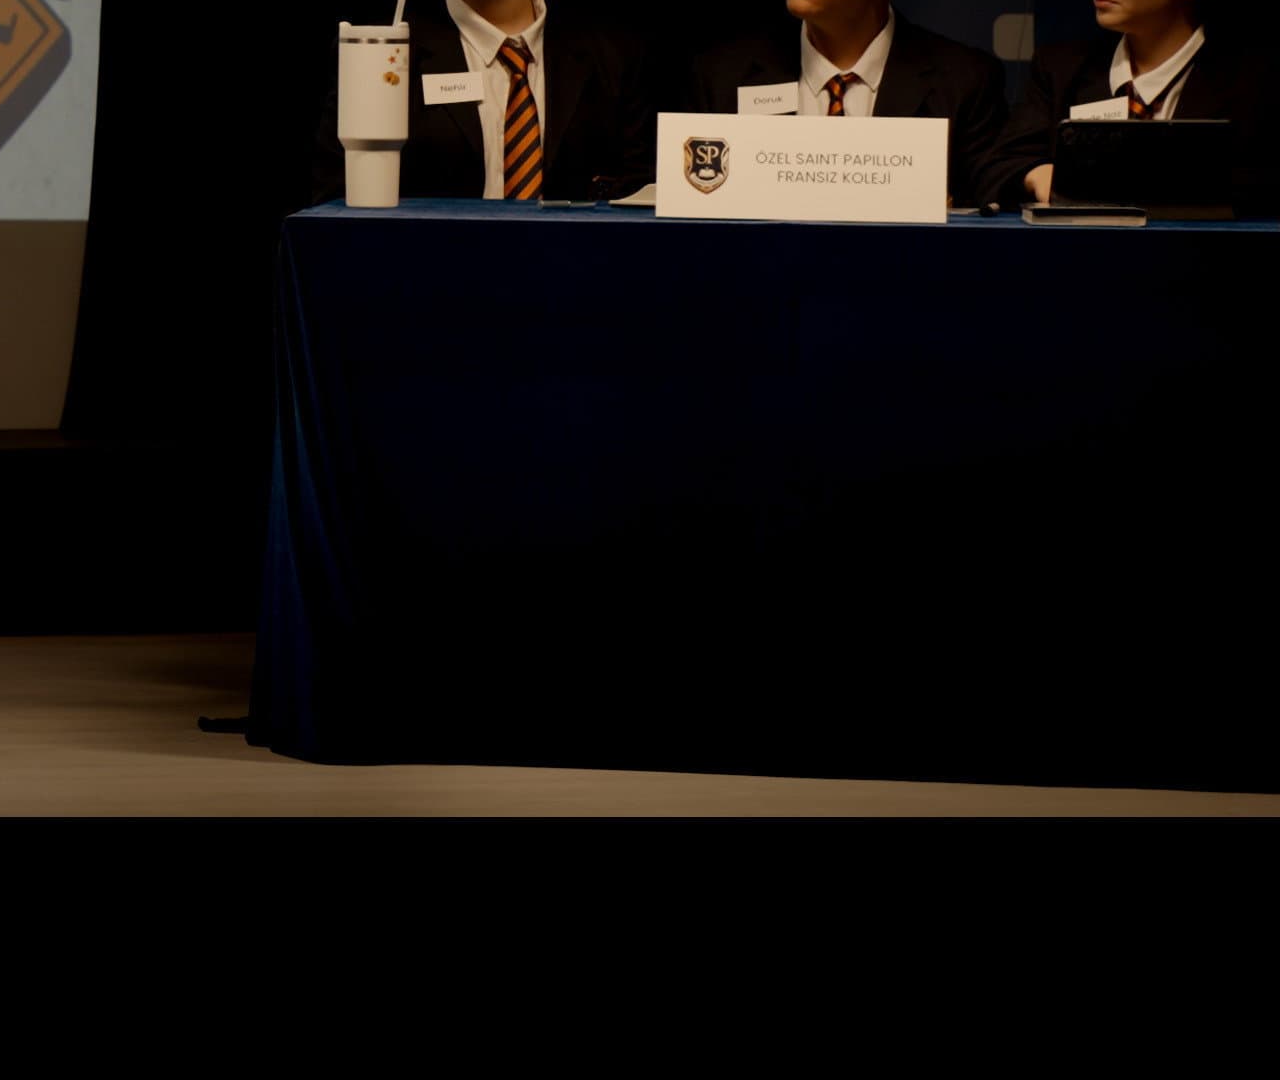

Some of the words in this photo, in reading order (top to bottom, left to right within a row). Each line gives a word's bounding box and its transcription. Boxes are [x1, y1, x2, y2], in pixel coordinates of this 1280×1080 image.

[755, 150, 790, 165] ÖZEL
[795, 152, 838, 165] SAINT
[843, 153, 913, 167] PAPILLON
[777, 170, 837, 184] FRANSIZ
